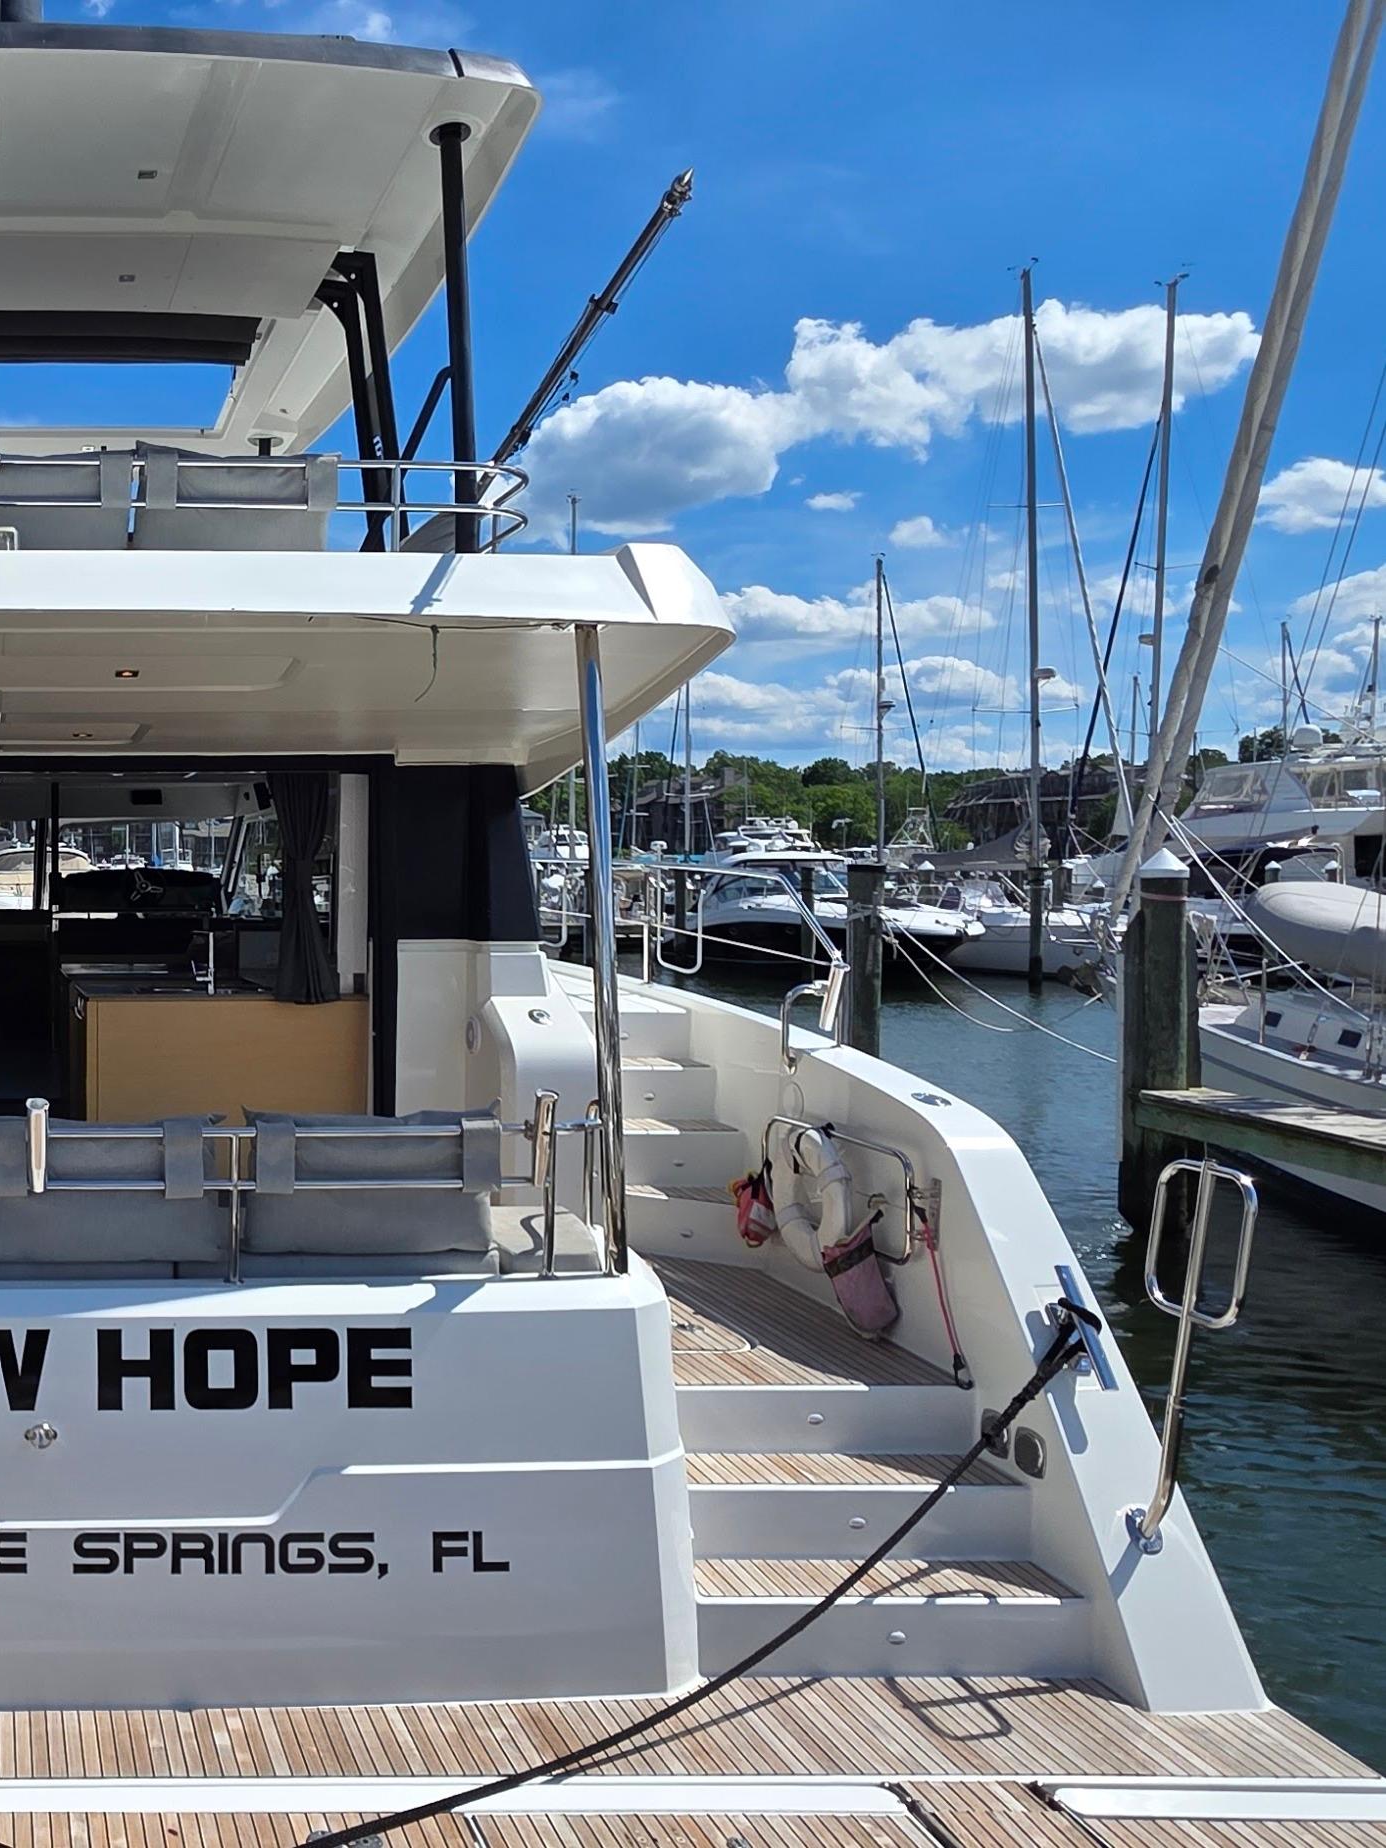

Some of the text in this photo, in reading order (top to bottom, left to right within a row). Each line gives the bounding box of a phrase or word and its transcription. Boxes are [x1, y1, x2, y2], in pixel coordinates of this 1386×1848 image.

[96, 1327, 413, 1411] HOPE
[72, 1531, 389, 1580] SPRINGS,
[431, 1531, 511, 1573] FL
